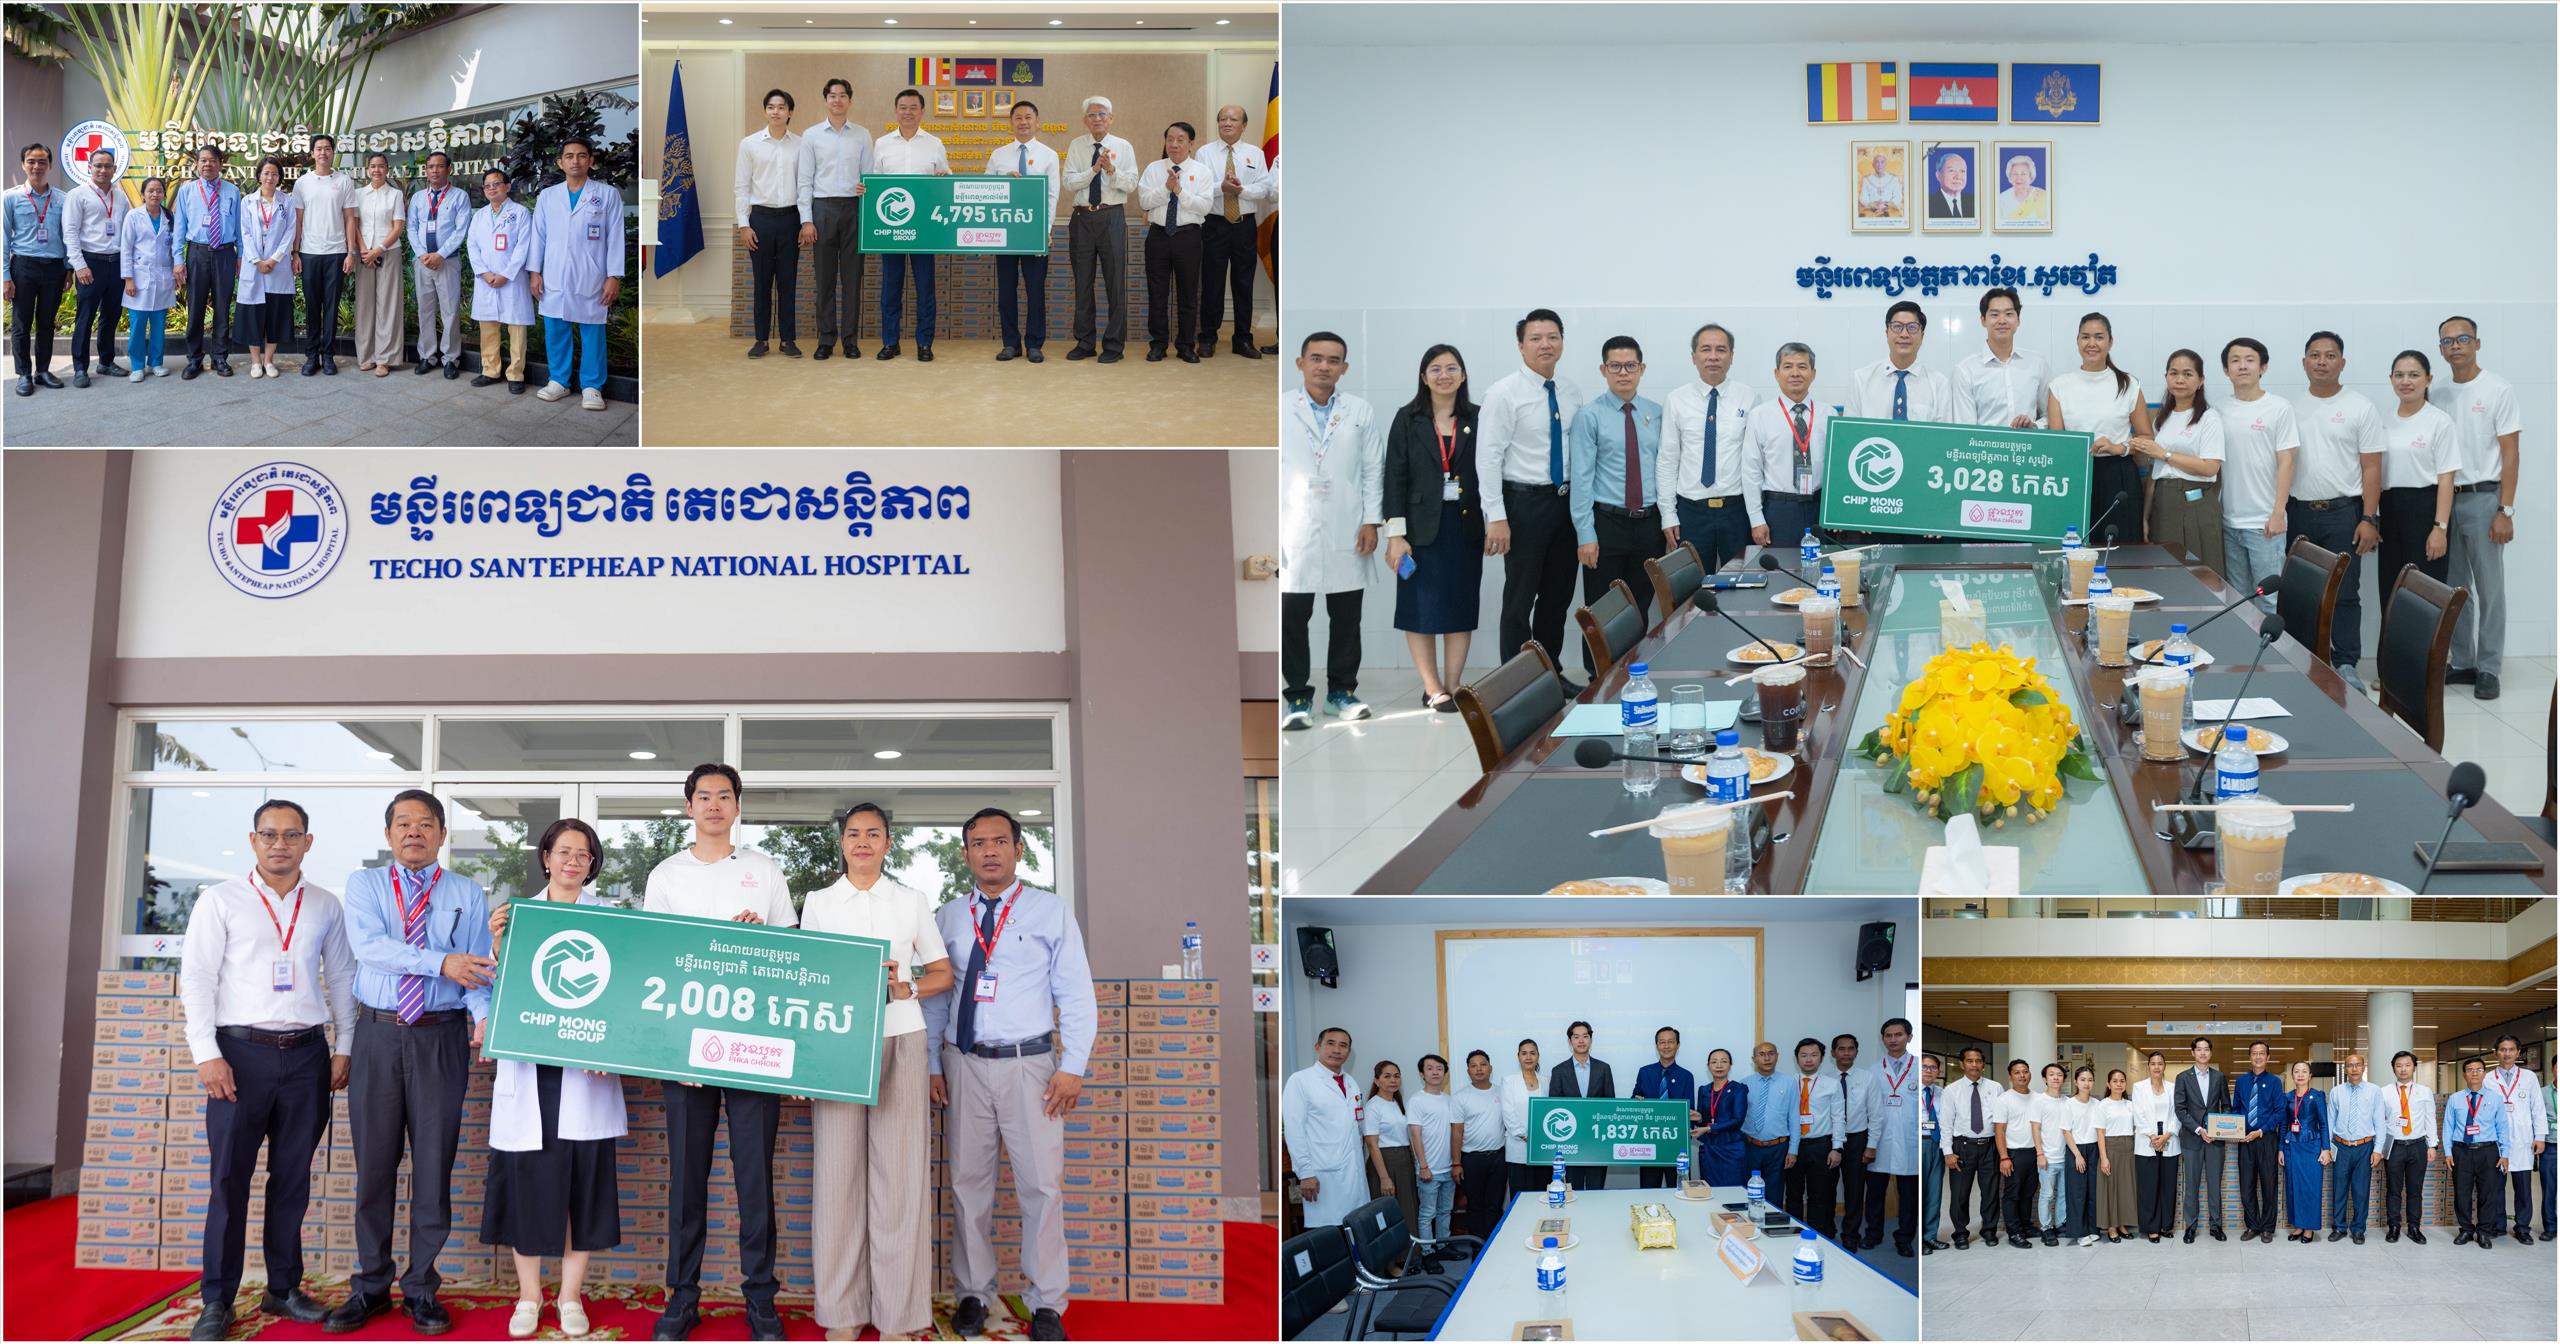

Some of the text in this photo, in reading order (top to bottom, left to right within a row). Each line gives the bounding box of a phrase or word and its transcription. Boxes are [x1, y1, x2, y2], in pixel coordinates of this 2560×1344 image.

[145, 165, 195, 179] TECH
[930, 205, 1034, 226] 4,795 កេស
[1927, 465, 2070, 497] 3,028 កេស
[370, 470, 970, 541] មន្ទីរពេទ្យជាតិ តេជោសន្តិភាព
[1843, 495, 1903, 507] CHIP MONG
[1870, 505, 1903, 514] GROUP
[217, 531, 229, 560] TECHO
[276, 567, 319, 589] NATIONAL
[317, 528, 339, 569] HOSPITAL
[369, 554, 970, 579] TECHO SANTEPHEAP NATIONAL HOSPITAL
[708, 938, 801, 964] អំណោយឧបត្ថម្ភជូន
[675, 953, 831, 986] មន្ទីរពេទ្យជាតិ តេជោសន្តិភាព
[640, 975, 855, 1034] 2,008 កេស
[519, 1011, 607, 1033] CHIP MONG
[557, 1028, 606, 1044] GROUP
[1592, 1124, 1678, 1141] 1,837 កេស
